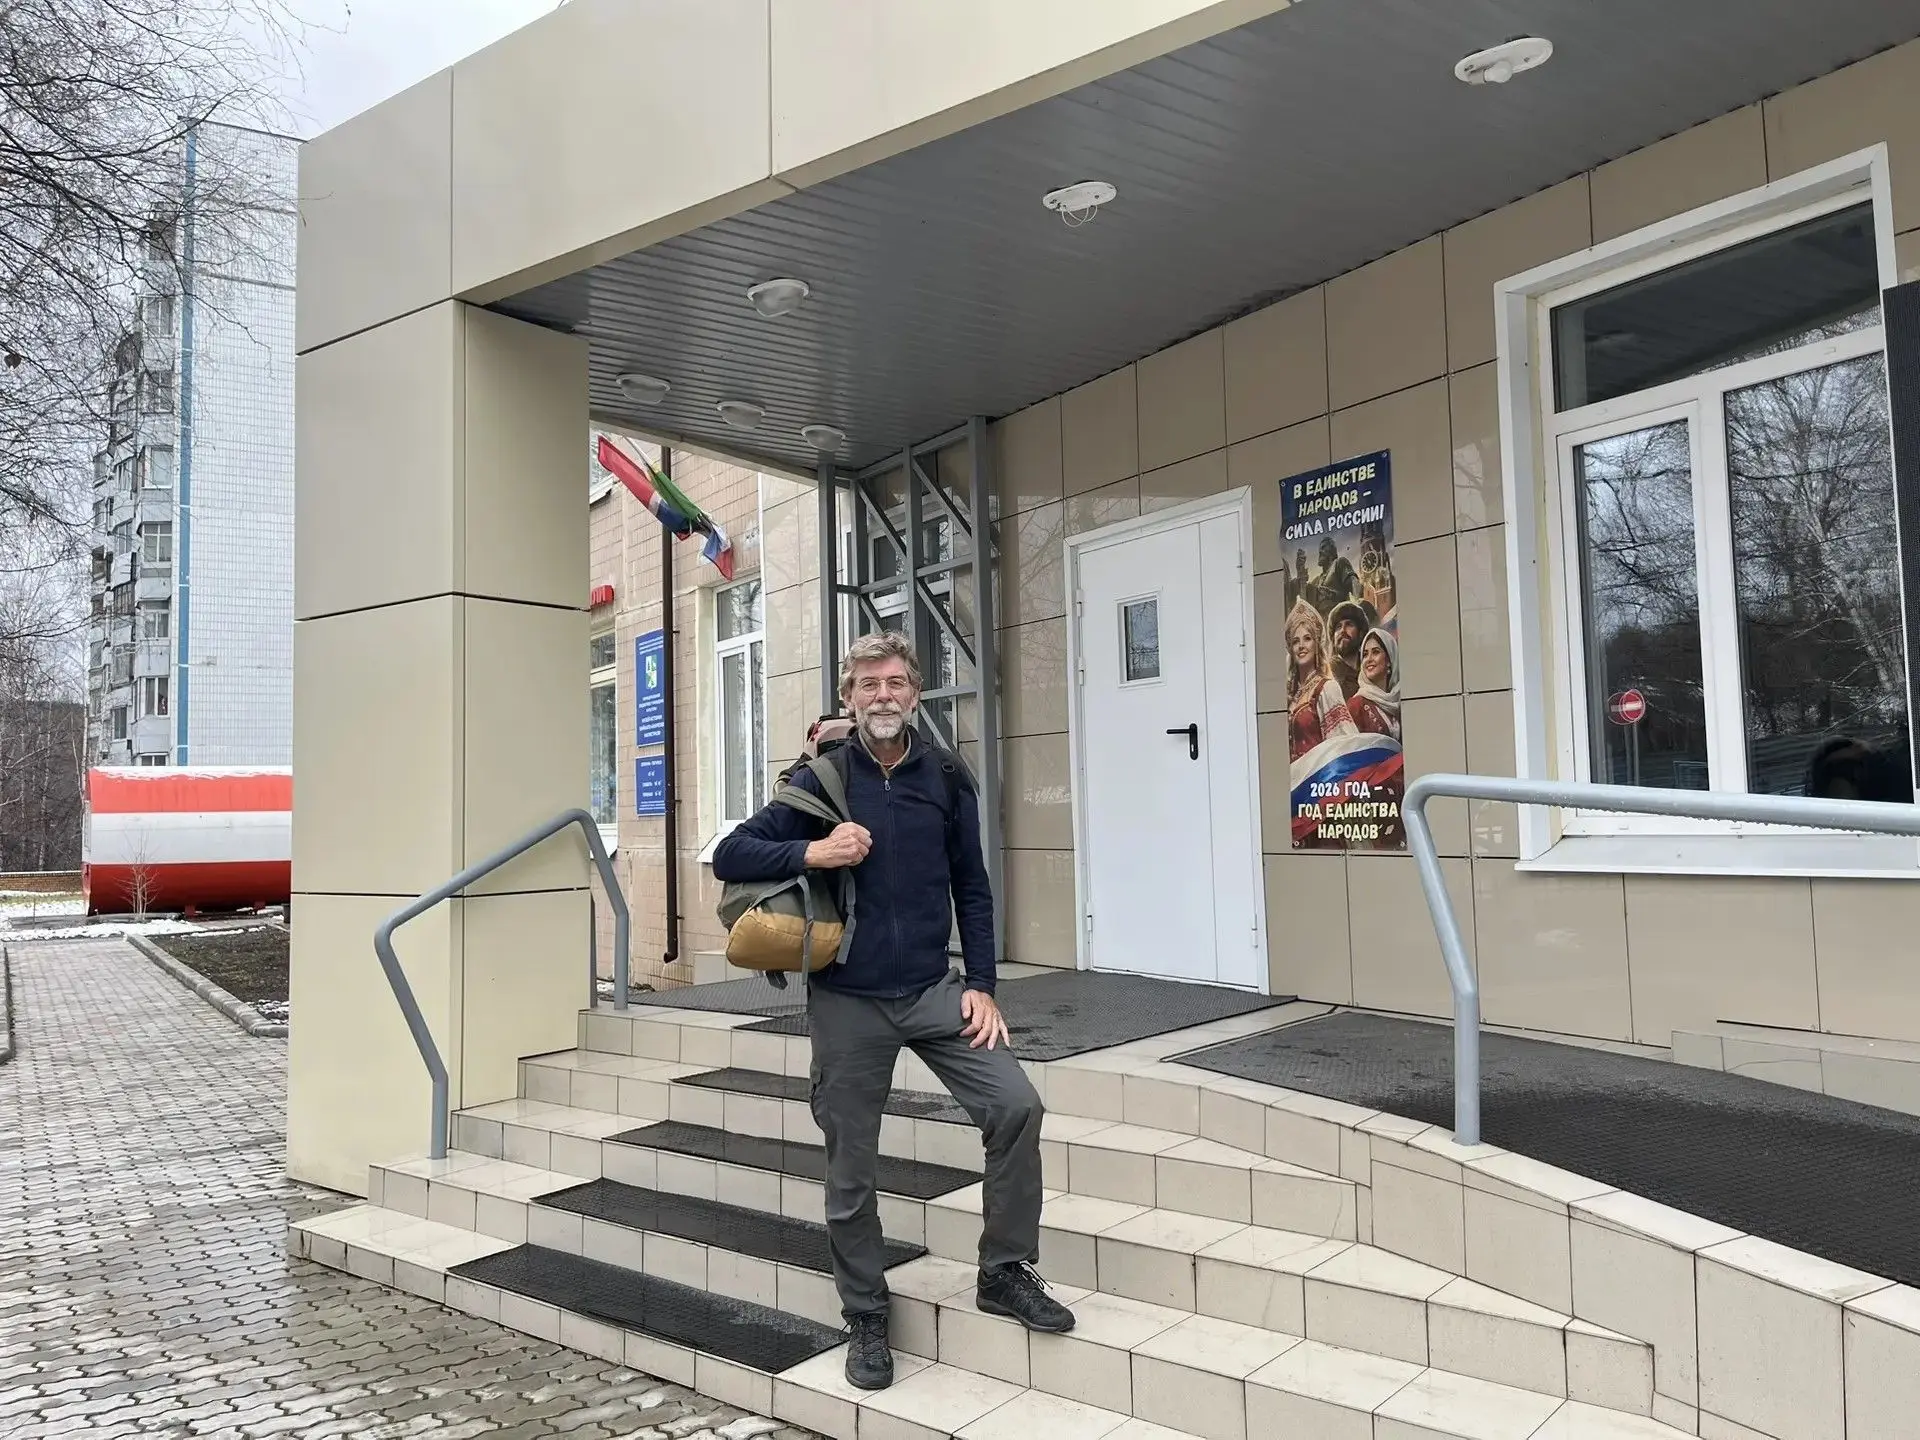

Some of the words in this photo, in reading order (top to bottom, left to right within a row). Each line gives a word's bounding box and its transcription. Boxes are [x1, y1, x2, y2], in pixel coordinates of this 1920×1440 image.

[1293, 483, 1302, 499] В
[1306, 462, 1376, 496] ЕДИНСТВЕ
[1298, 489, 1358, 518] НАРОДОВ
[1285, 519, 1323, 540] СИЛА
[1327, 504, 1385, 532] РОССИИ!
[1310, 782, 1340, 797] 2026
[1344, 781, 1371, 799] ГОД
[1298, 803, 1322, 820] ГОД
[1325, 802, 1399, 820] ЕДИНСТВА
[1317, 824, 1379, 841] НАРОДОВ
